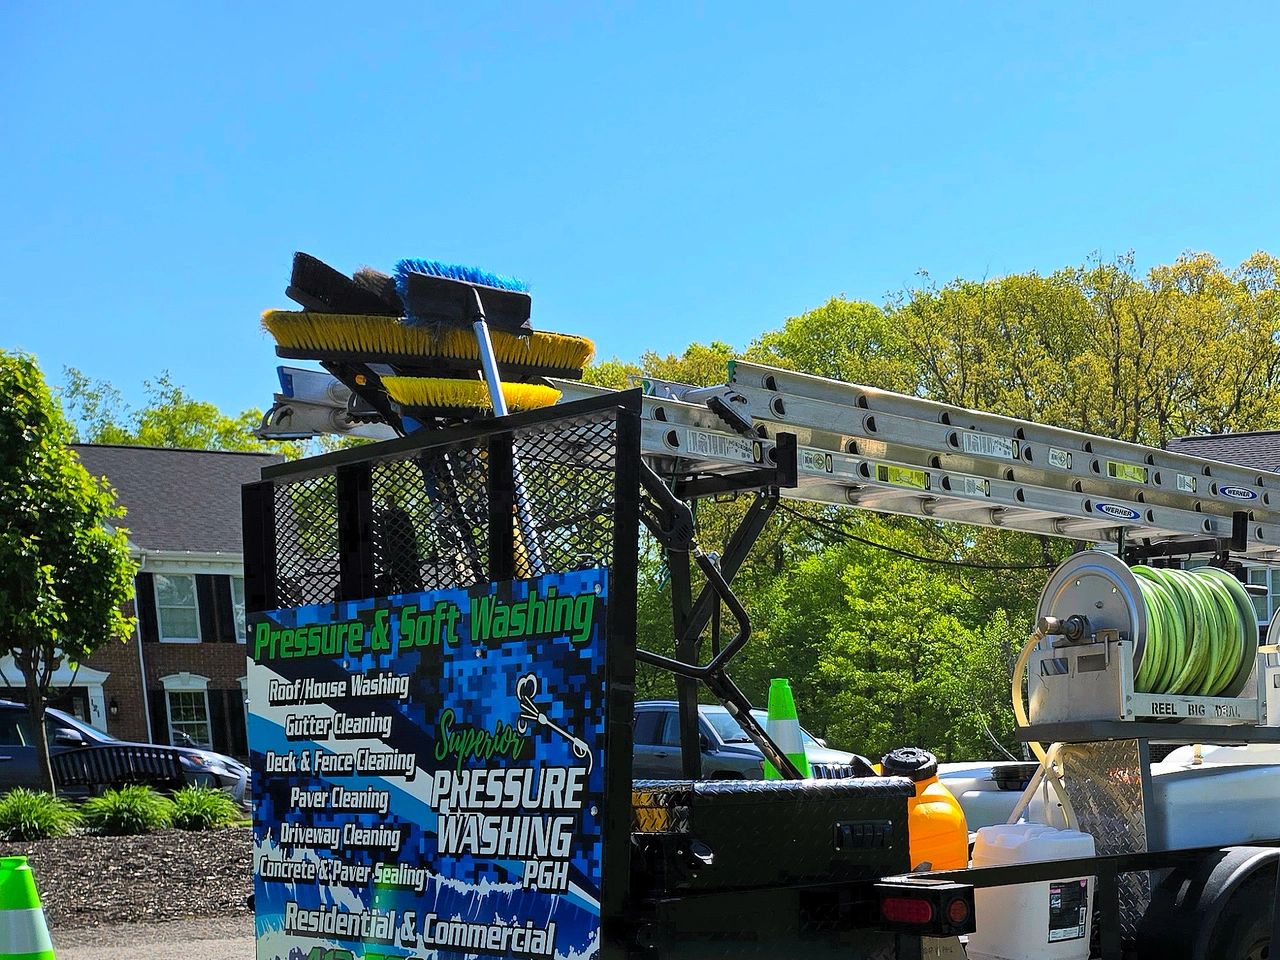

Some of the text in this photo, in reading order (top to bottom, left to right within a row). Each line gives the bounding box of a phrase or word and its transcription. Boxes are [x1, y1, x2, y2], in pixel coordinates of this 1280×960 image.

[1227, 488, 1250, 498] WERNER
[1104, 505, 1133, 517] WERNER
[254, 587, 596, 660] Pressure & Soft Washing
[269, 671, 410, 702] Roof/House Washing
[285, 711, 393, 737] Gutter Cleaning
[1151, 702, 1240, 717] REEL BIG DEAL
[435, 709, 526, 772] Superior
[266, 749, 416, 776] Deck & Fence Cleaning
[290, 787, 389, 813] Paver Cleaning
[431, 768, 586, 809] PRESSURE
[280, 823, 401, 851] Driveway Cleaning
[436, 815, 574, 857] WASHING
[259, 859, 426, 891] Concrete & Paver Sealing
[523, 860, 569, 890] PGH
[284, 902, 556, 955] Residential & Commercial
